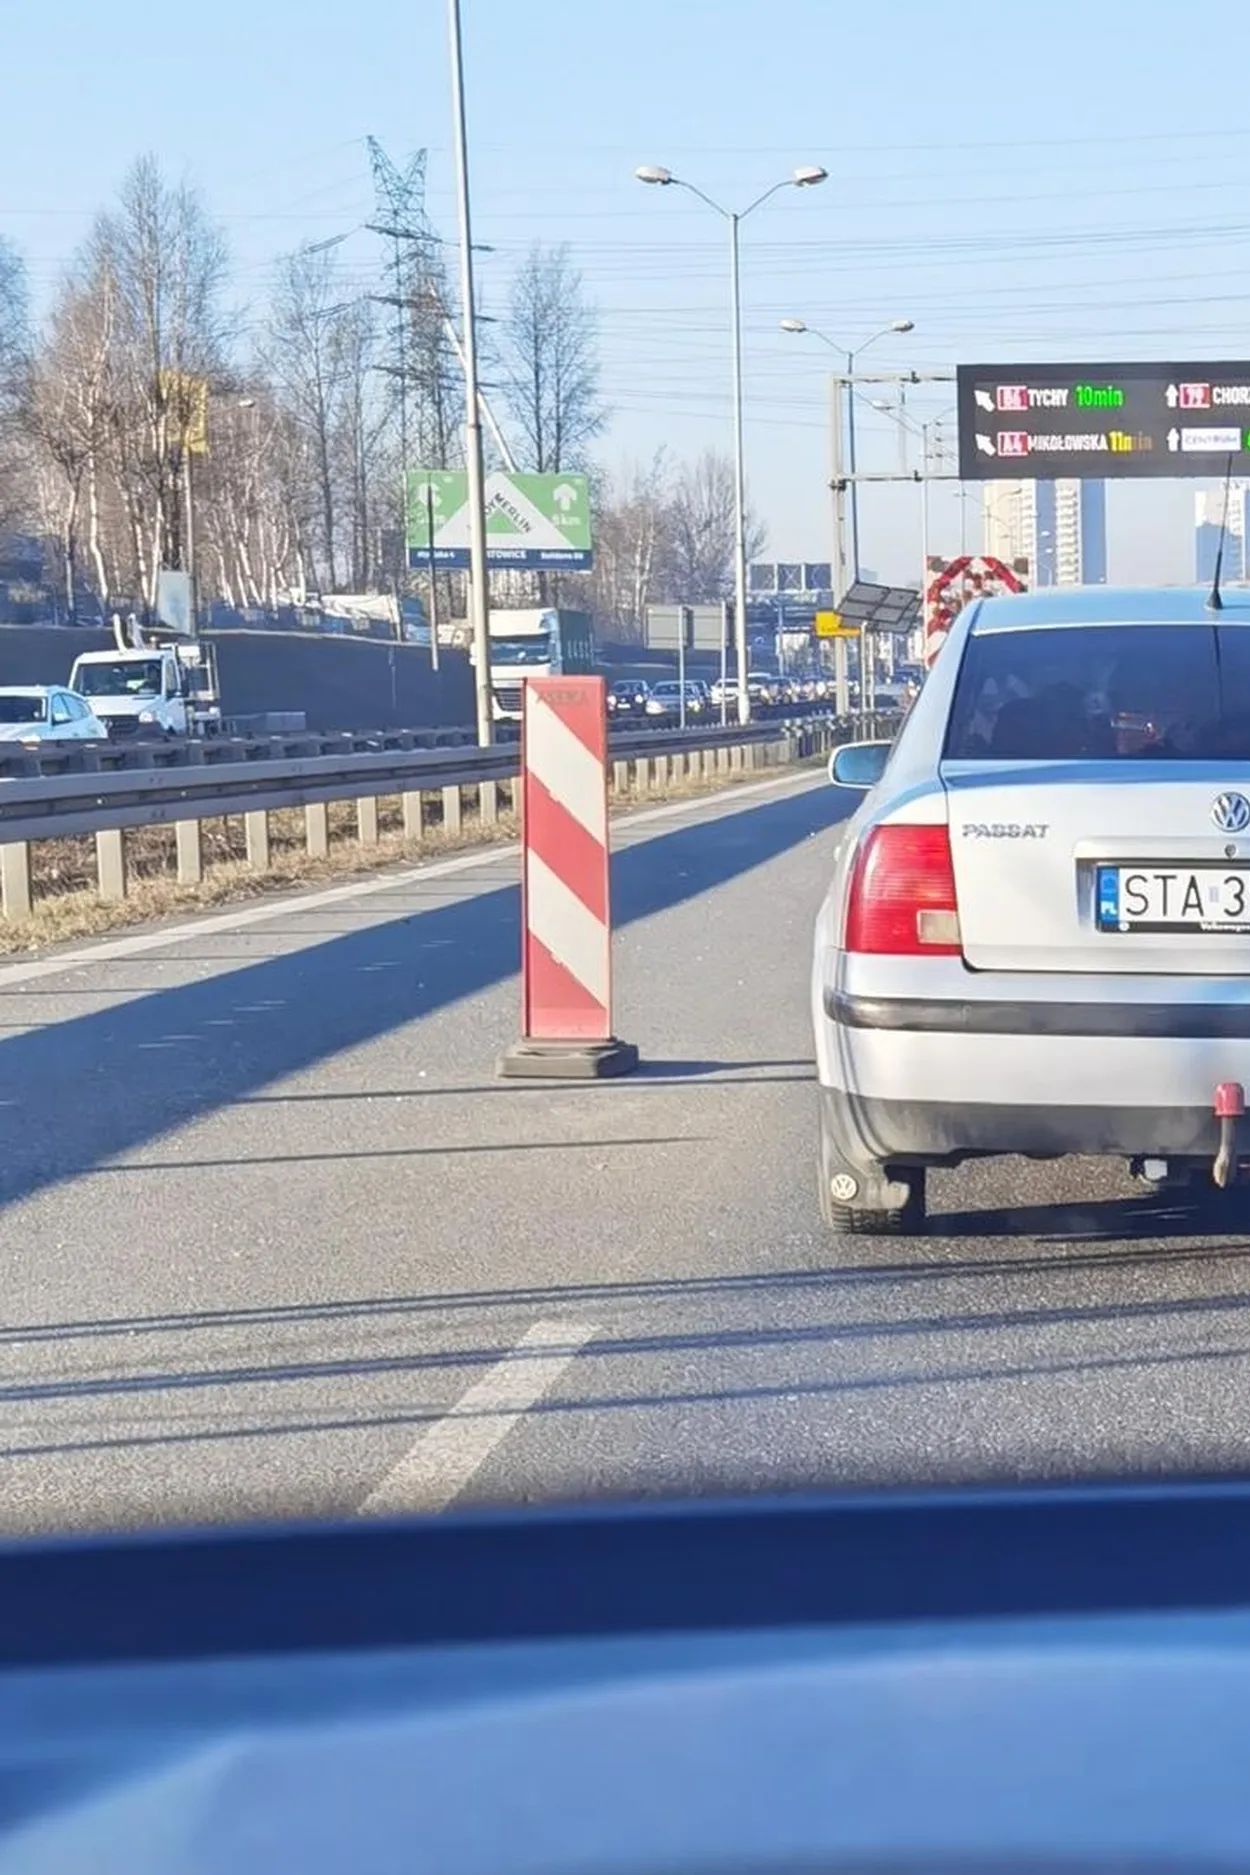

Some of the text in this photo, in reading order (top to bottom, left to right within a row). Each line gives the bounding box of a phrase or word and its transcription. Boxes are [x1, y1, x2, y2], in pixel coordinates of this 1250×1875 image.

[1028, 388, 1068, 407] TYCHY
[1076, 385, 1123, 407] 10min
[1028, 434, 1108, 451] MIKOŁOWSKA
[962, 823, 1050, 839] PASSAT
[1125, 874, 1204, 917] STA
